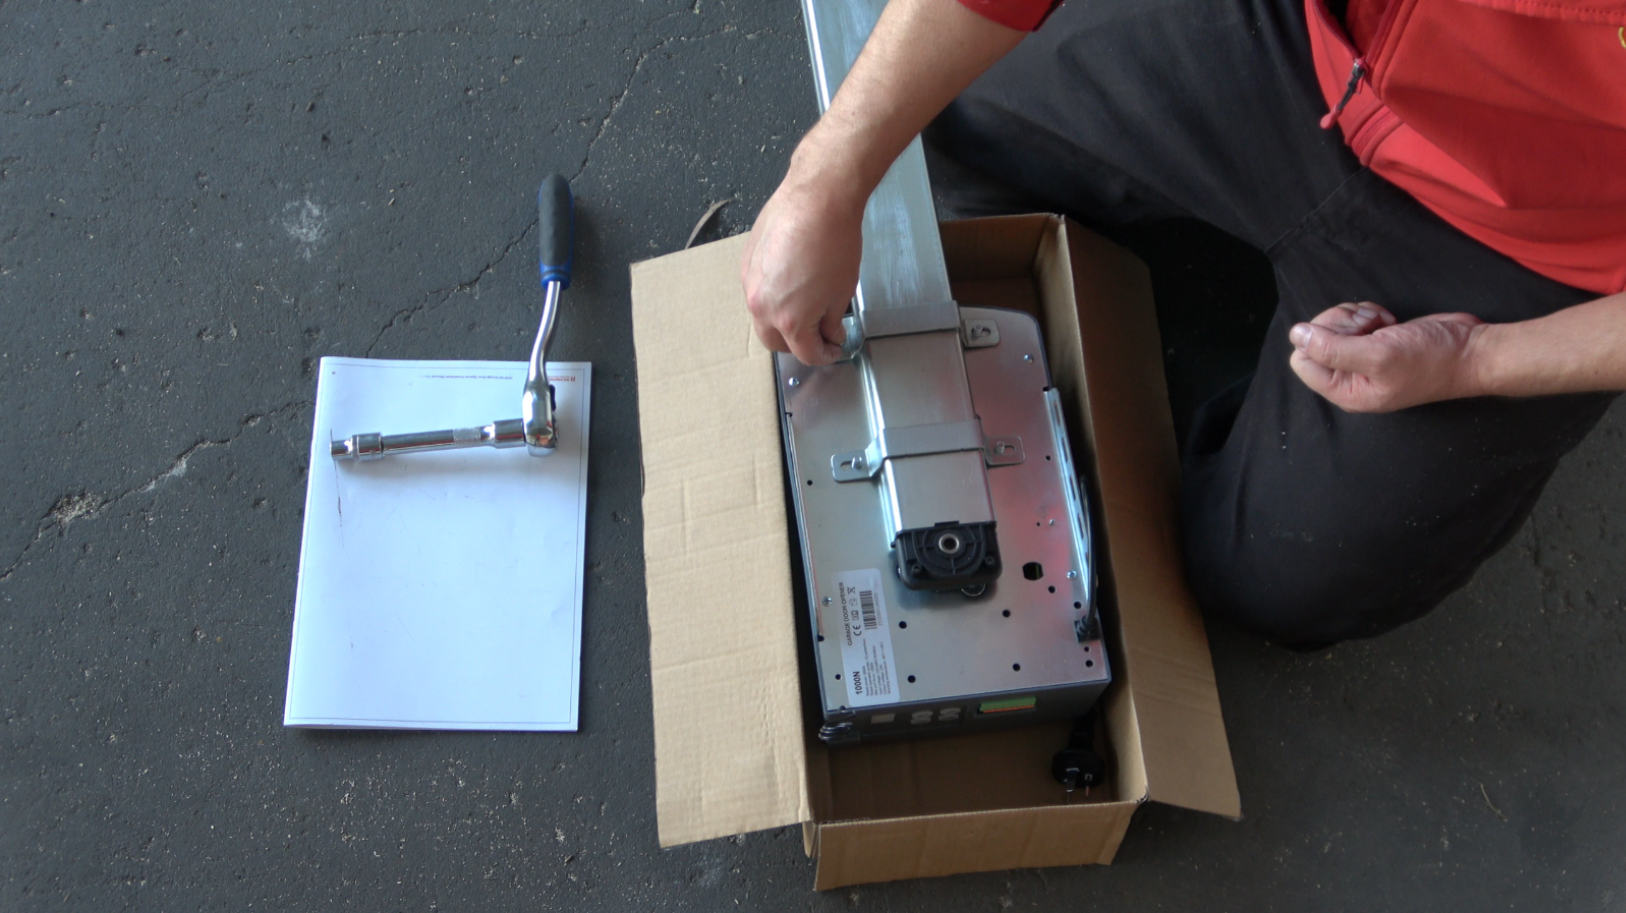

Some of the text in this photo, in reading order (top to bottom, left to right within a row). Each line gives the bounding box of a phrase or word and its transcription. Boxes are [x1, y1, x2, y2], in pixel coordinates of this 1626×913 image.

[839, 582, 847, 605] OPENER
[845, 624, 853, 646] GARAGE
[853, 671, 863, 695] 1000N
